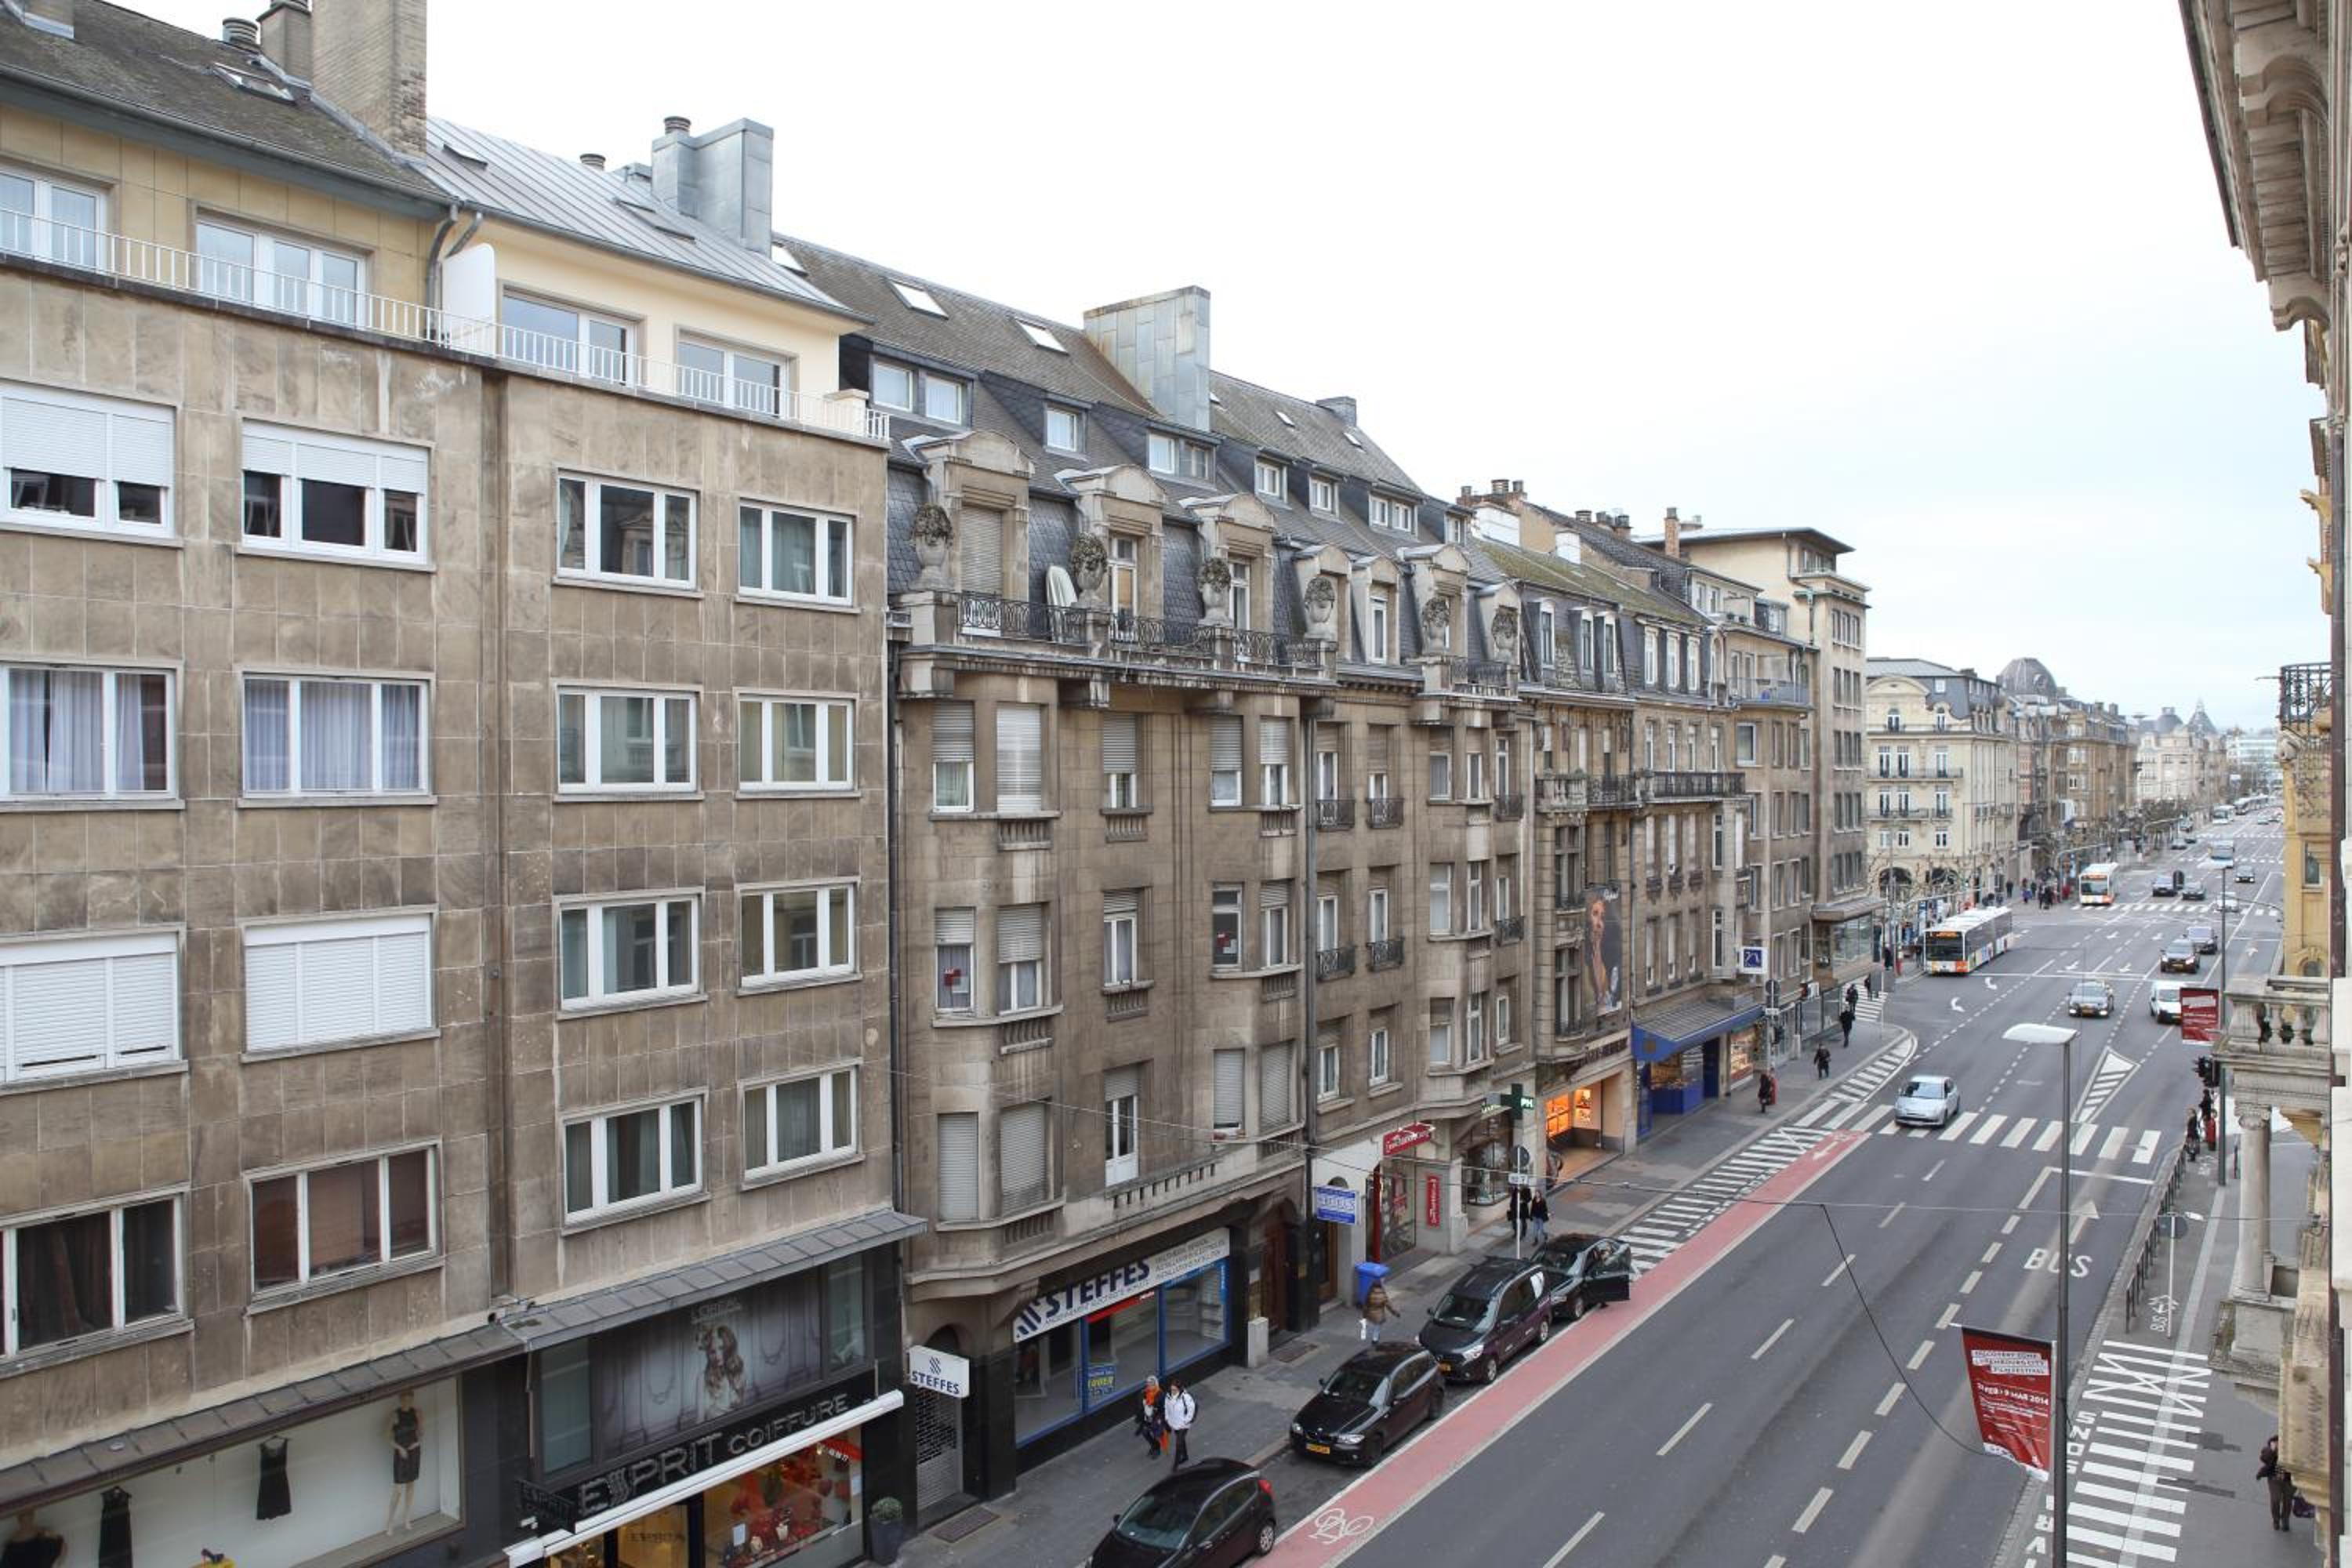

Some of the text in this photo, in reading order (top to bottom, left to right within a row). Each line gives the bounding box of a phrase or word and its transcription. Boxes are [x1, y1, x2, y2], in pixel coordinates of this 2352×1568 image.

[2024, 1248, 2092, 1277] BUS
[1045, 1256, 1150, 1318] STEFFES
[912, 1371, 960, 1395] STEFFES
[2011, 1391, 2029, 1401] MAR
[2030, 1396, 2049, 1406] 2014
[579, 1393, 848, 1517] ESPRIT COIFFURE
